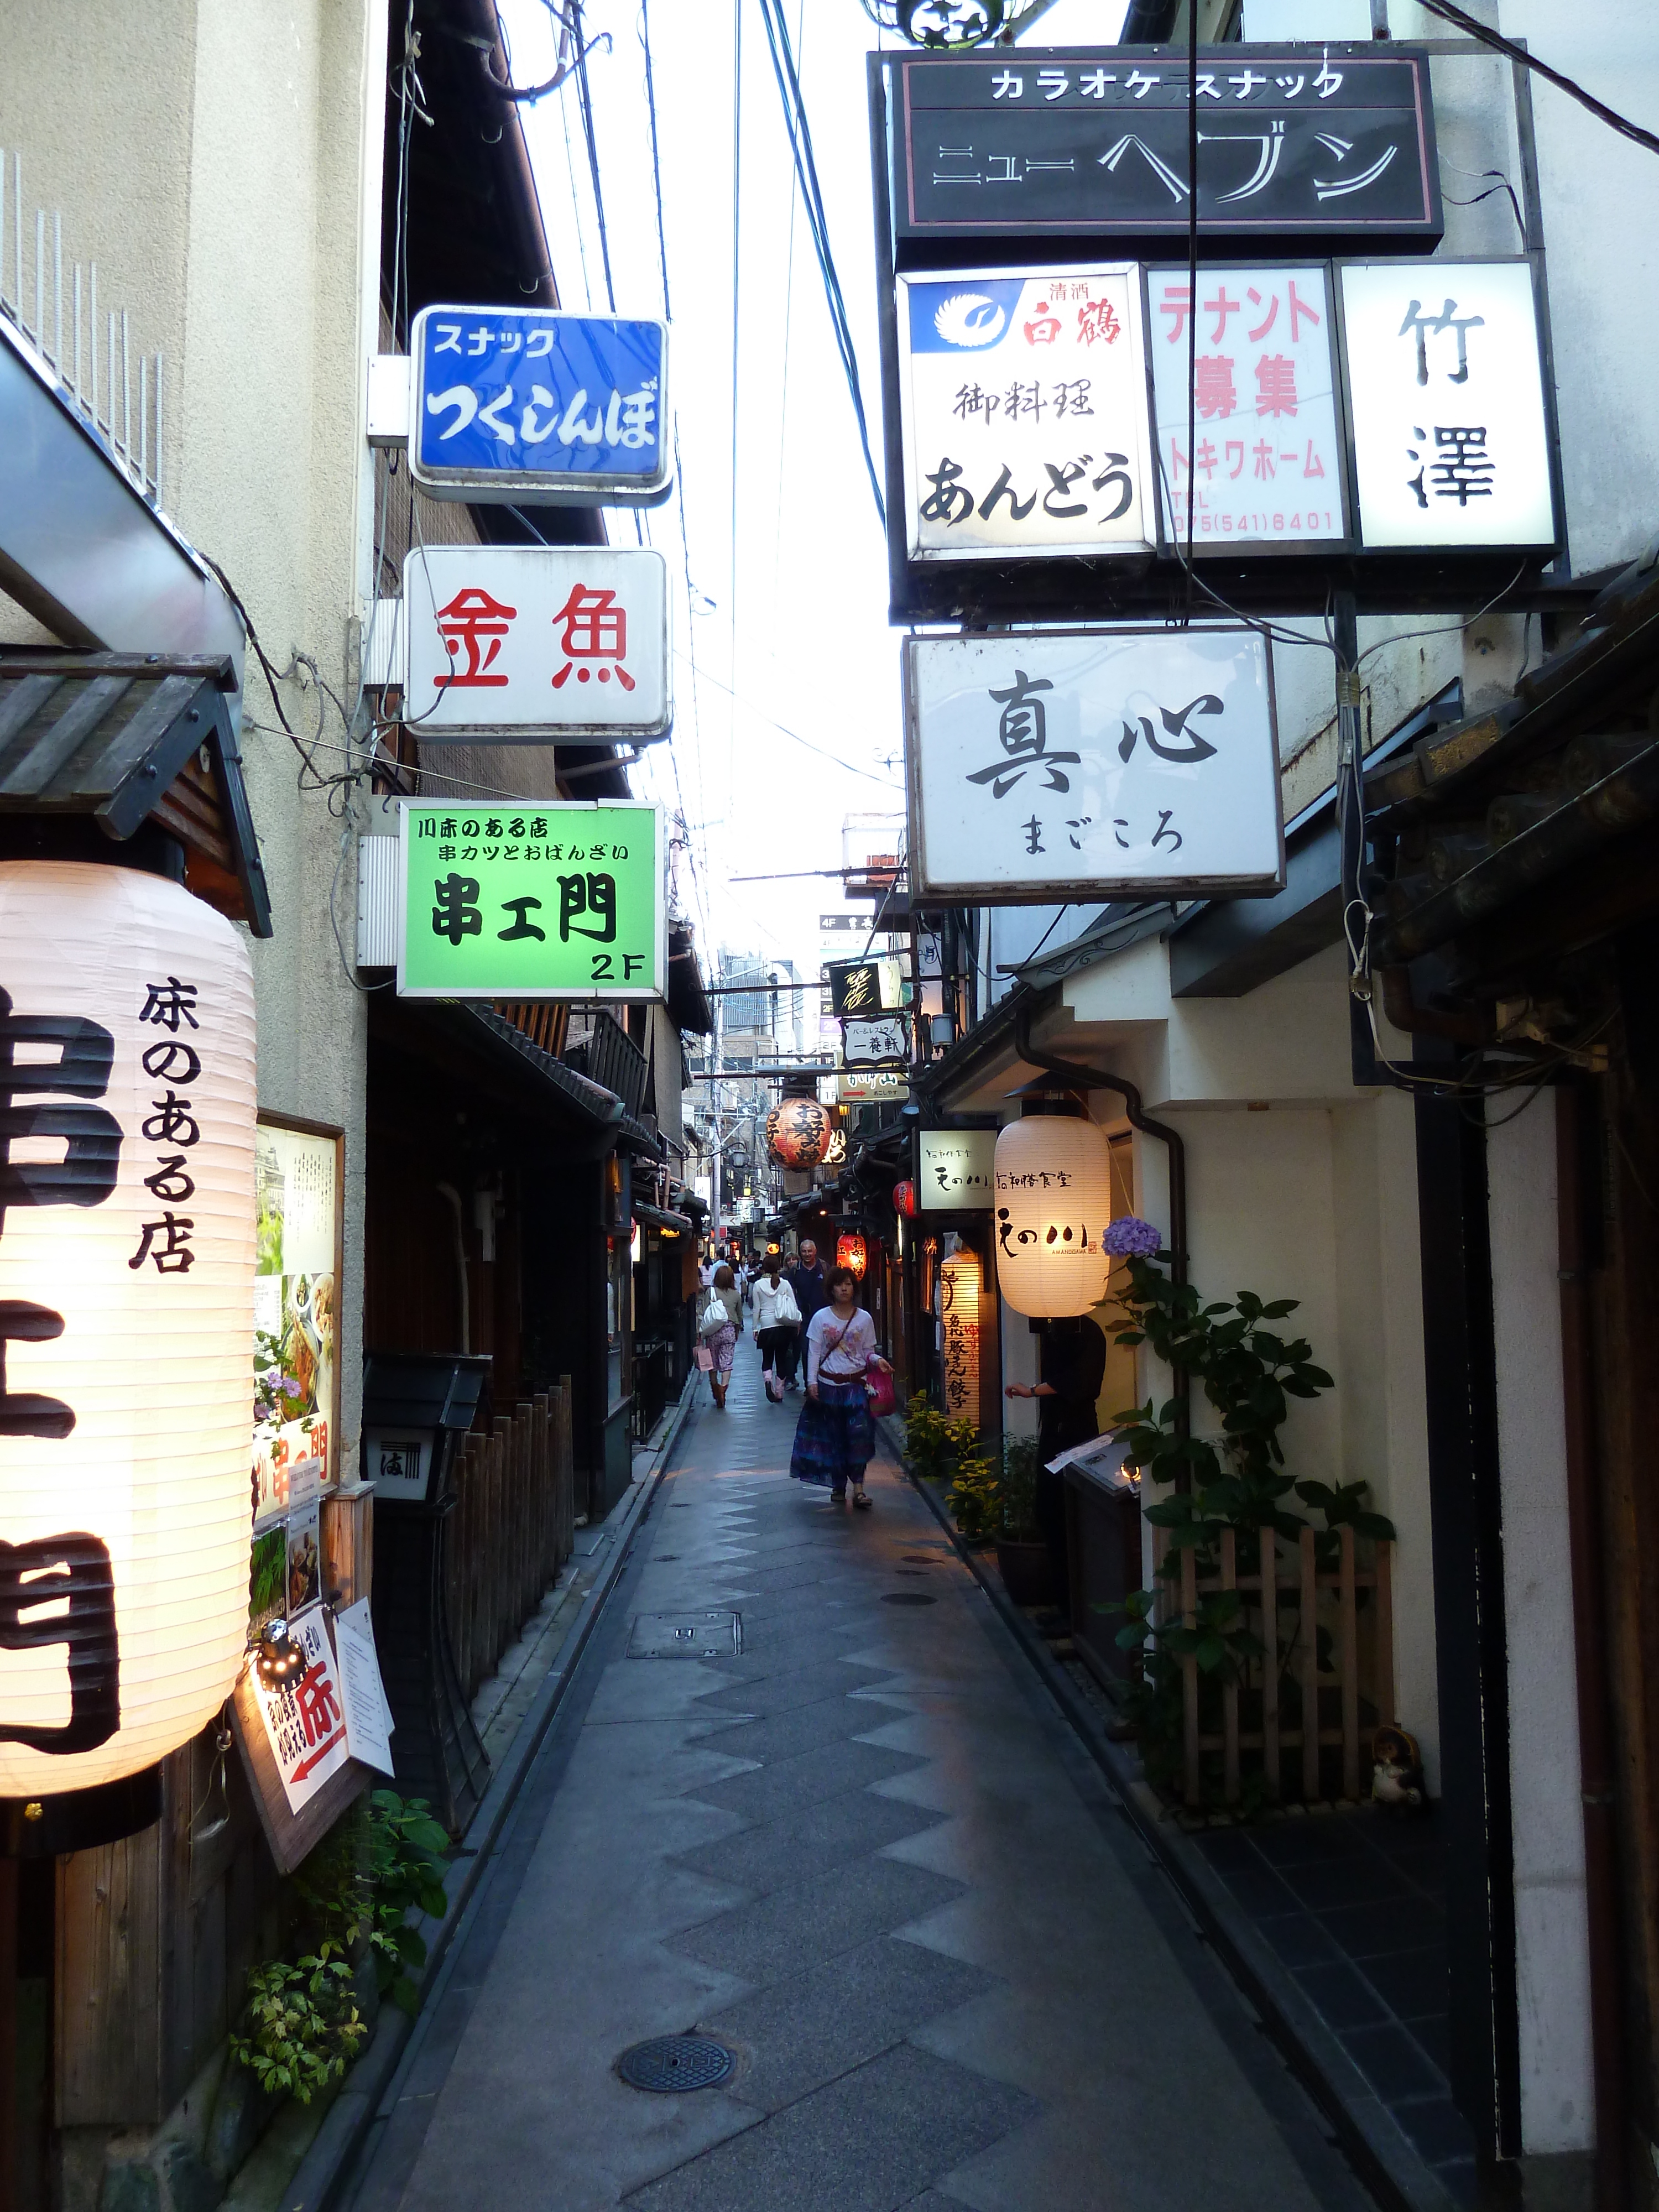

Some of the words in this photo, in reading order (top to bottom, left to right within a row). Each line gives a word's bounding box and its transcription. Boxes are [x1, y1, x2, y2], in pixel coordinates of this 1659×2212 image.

[992, 69, 1160, 100] カラオケ
[1190, 67, 1344, 98] スナック
[1049, 283, 1089, 302] 清酒
[1160, 280, 1321, 344] テナント
[434, 325, 554, 358] スナック
[1024, 298, 1121, 347] 白鶴
[953, 378, 1095, 426] 御料理
[1193, 355, 1300, 418] 募集
[1398, 299, 1496, 509] 竹澤
[427, 377, 658, 450] つくしんぼ
[1171, 439, 1326, 482] トキワホーム
[920, 451, 1133, 528] あんどう
[434, 583, 635, 691] 金魚
[966, 669, 1224, 800] 真心
[418, 817, 549, 838] 川床のある店
[1021, 810, 1183, 855] まごころ
[438, 843, 629, 861] 串カツとおばんざい
[822, 918, 836, 928] 4F
[591, 953, 646, 980] 2F
[854, 1036, 899, 1054] 一養軒
[128, 976, 202, 1275] 床のある店
[998, 1207, 1088, 1259] 天の川
